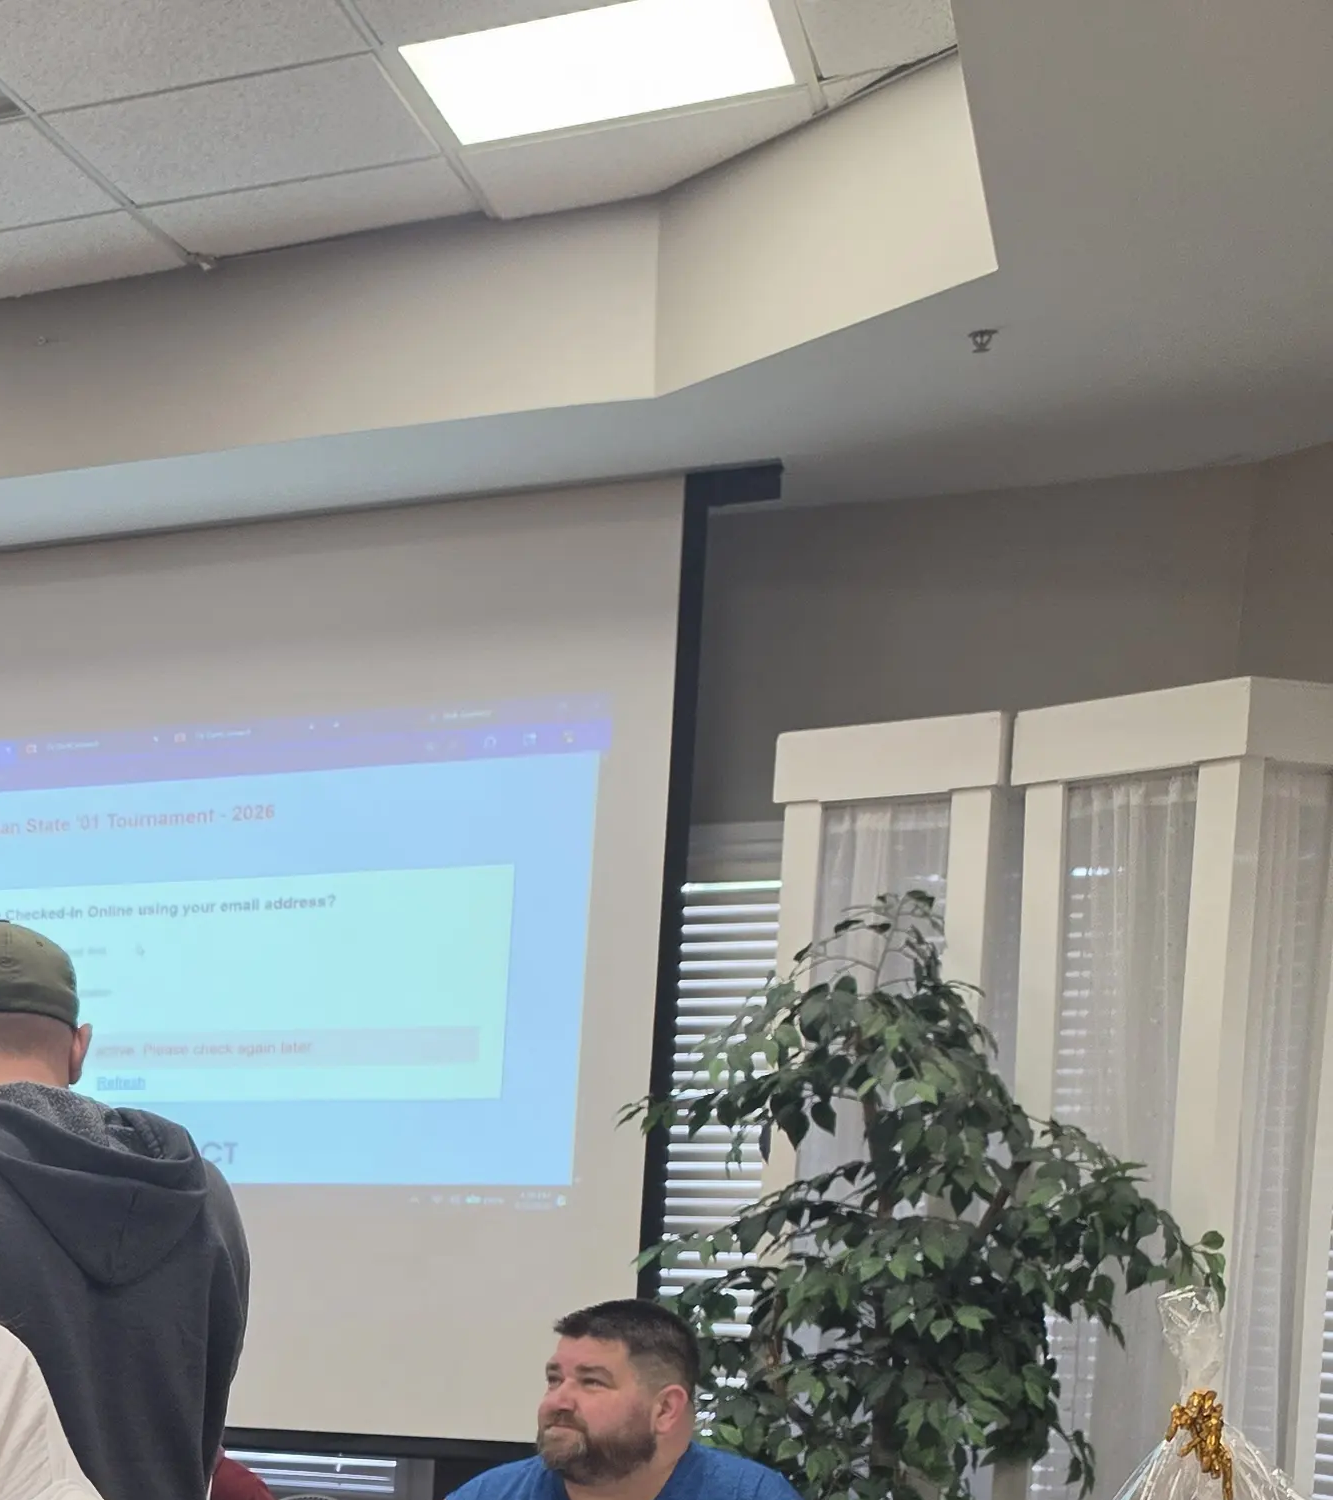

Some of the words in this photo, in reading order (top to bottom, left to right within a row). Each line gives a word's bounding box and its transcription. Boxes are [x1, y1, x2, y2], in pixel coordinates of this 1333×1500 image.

[26, 817, 70, 833] State
[107, 807, 214, 829] Tournament
[232, 804, 275, 822] 2026
[5, 907, 83, 921] Checked-In
[88, 905, 132, 918] Online
[138, 902, 178, 917] using
[183, 901, 216, 917] your
[220, 897, 259, 913] email
[264, 894, 336, 910] address?
[143, 1043, 189, 1057] Please
[193, 1041, 232, 1056] check
[237, 1042, 276, 1057] again
[97, 1076, 146, 1091] Refresh
